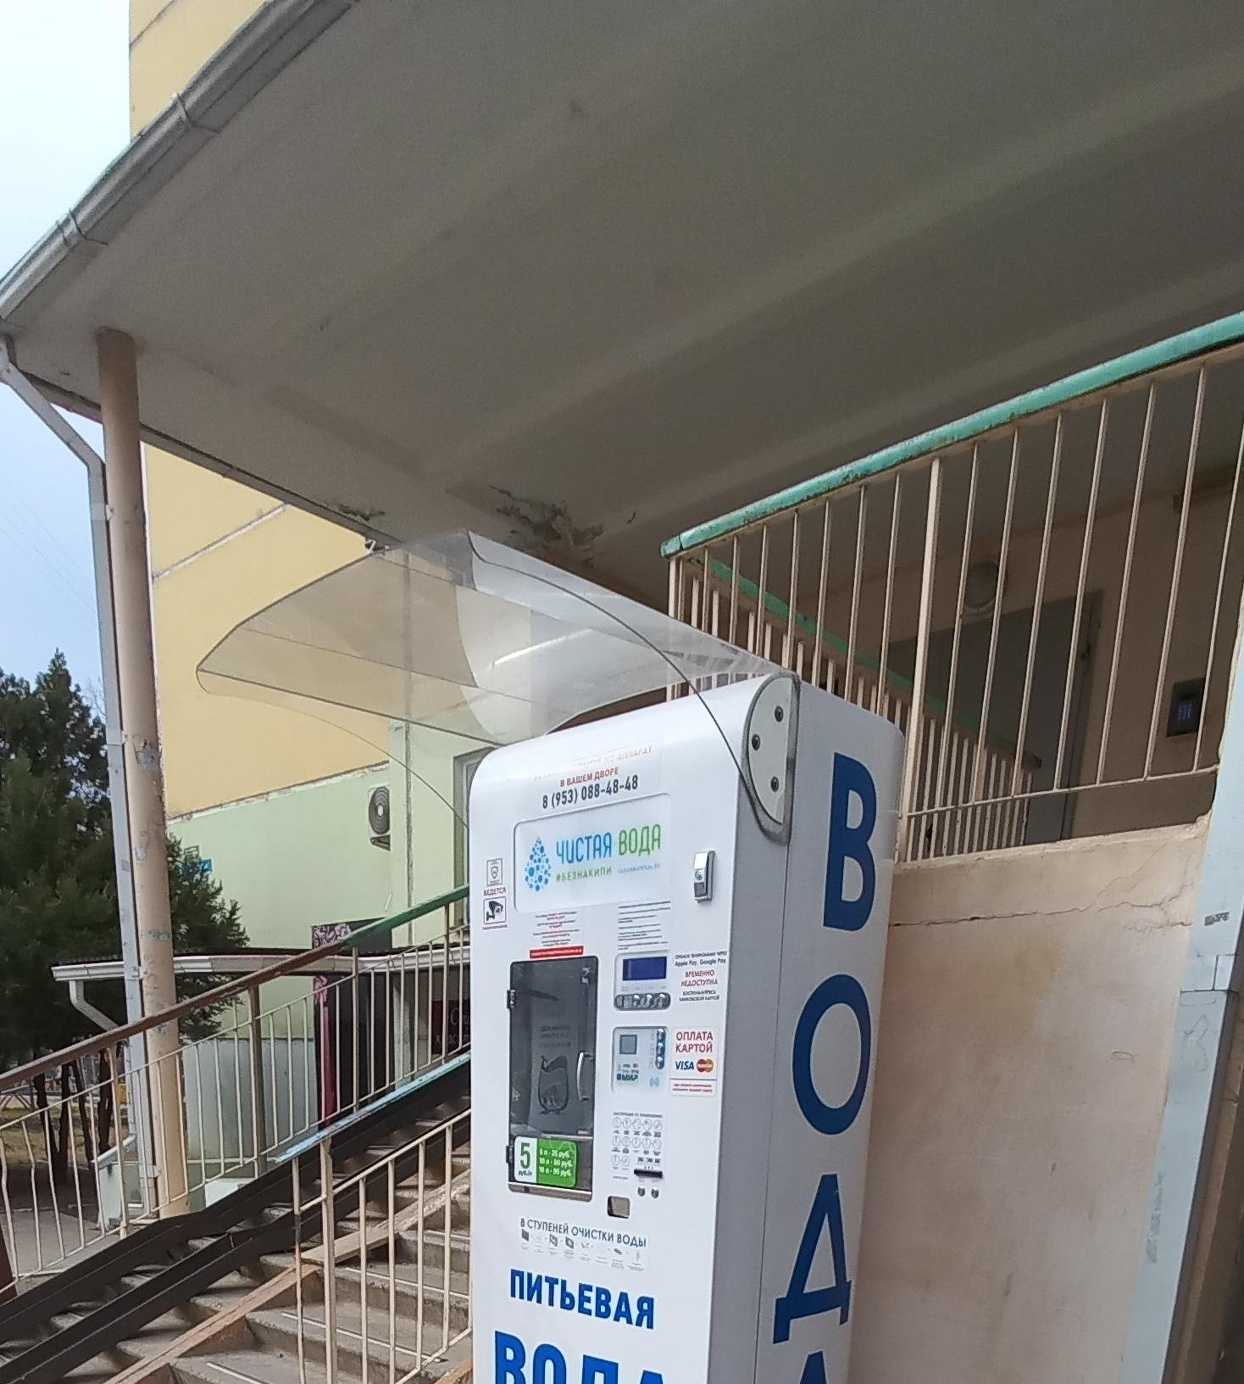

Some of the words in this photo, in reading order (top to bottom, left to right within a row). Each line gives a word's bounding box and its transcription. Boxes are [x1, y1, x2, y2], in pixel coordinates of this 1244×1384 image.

[566, 772, 593, 786] ВАШЕМ
[594, 767, 619, 780] ДВОРЕ
[542, 795, 548, 809] 8
[551, 789, 578, 808] (953)
[581, 774, 639, 801] 088-48-48
[556, 832, 612, 864] ЧИСТАЯ
[618, 824, 661, 856] ВОДА
[675, 1041, 713, 1053] КАРТОЙ
[676, 1031, 713, 1041] ОПЛАТА
[675, 1060, 694, 1070] VISA
[520, 1142, 530, 1169] 5
[527, 1219, 569, 1234] СТУПЕНЕЙ
[571, 1226, 614, 1242] ОЧИСТКИ
[617, 1233, 647, 1247] ВОДЫ
[510, 1268, 655, 1329] ПИТЬЕВАЯ
